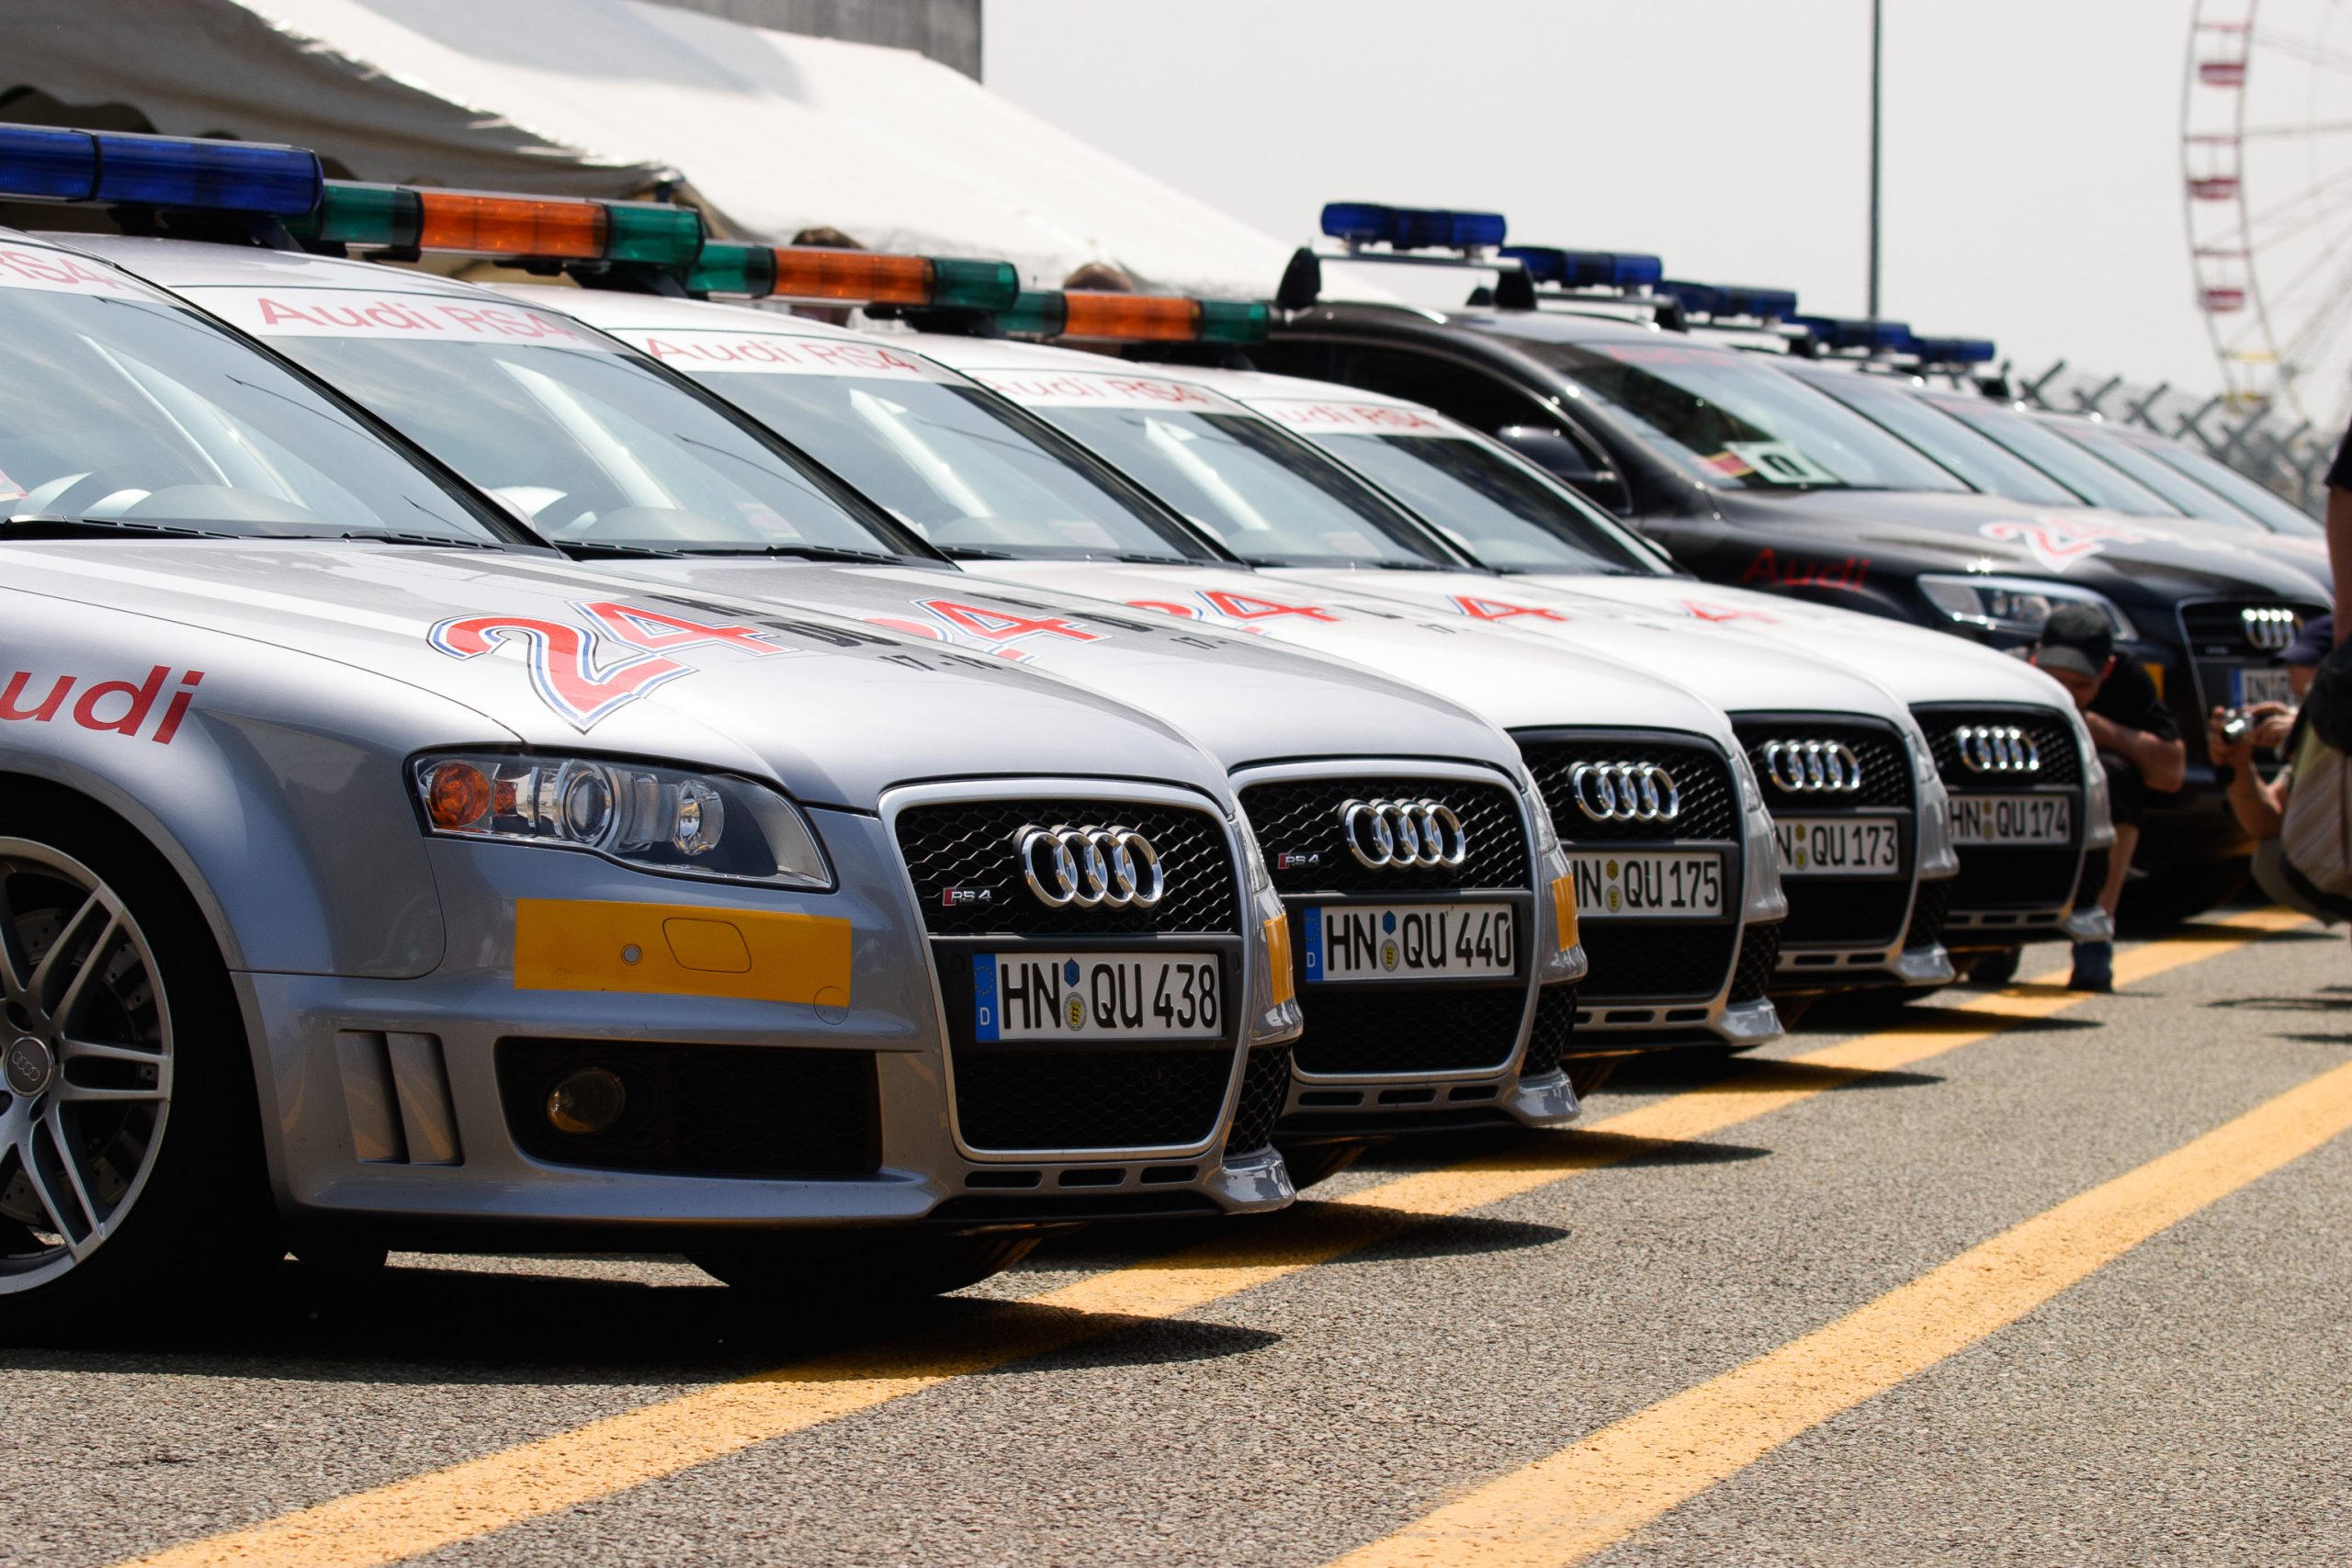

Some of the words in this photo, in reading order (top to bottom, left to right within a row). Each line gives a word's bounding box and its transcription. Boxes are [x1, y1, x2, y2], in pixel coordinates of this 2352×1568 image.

[257, 298, 444, 331] Audi
[434, 306, 577, 339] RS4
[646, 338, 803, 363] Audi
[797, 344, 920, 372] RS4
[1276, 405, 1356, 424] udi
[1742, 547, 1871, 592] Audi
[425, 599, 799, 735] 24
[0, 665, 205, 745] udi
[1949, 801, 1981, 839] HN
[1996, 800, 2026, 838] QU
[2030, 801, 2067, 839] 174
[1775, 825, 1792, 866] N
[1812, 825, 1847, 866] QU
[1852, 826, 1895, 866] 173
[1573, 860, 1602, 908] N
[1624, 860, 1663, 908] QU
[1669, 860, 1718, 908] 175
[1306, 952, 1316, 968] D
[1326, 913, 1377, 971] HN
[1402, 912, 1448, 968] QU
[1454, 911, 1511, 968] 440
[979, 1007, 990, 1026] D
[1001, 962, 1061, 1030] HN
[1091, 962, 1144, 1029] QU
[1153, 963, 1217, 1029] 438
